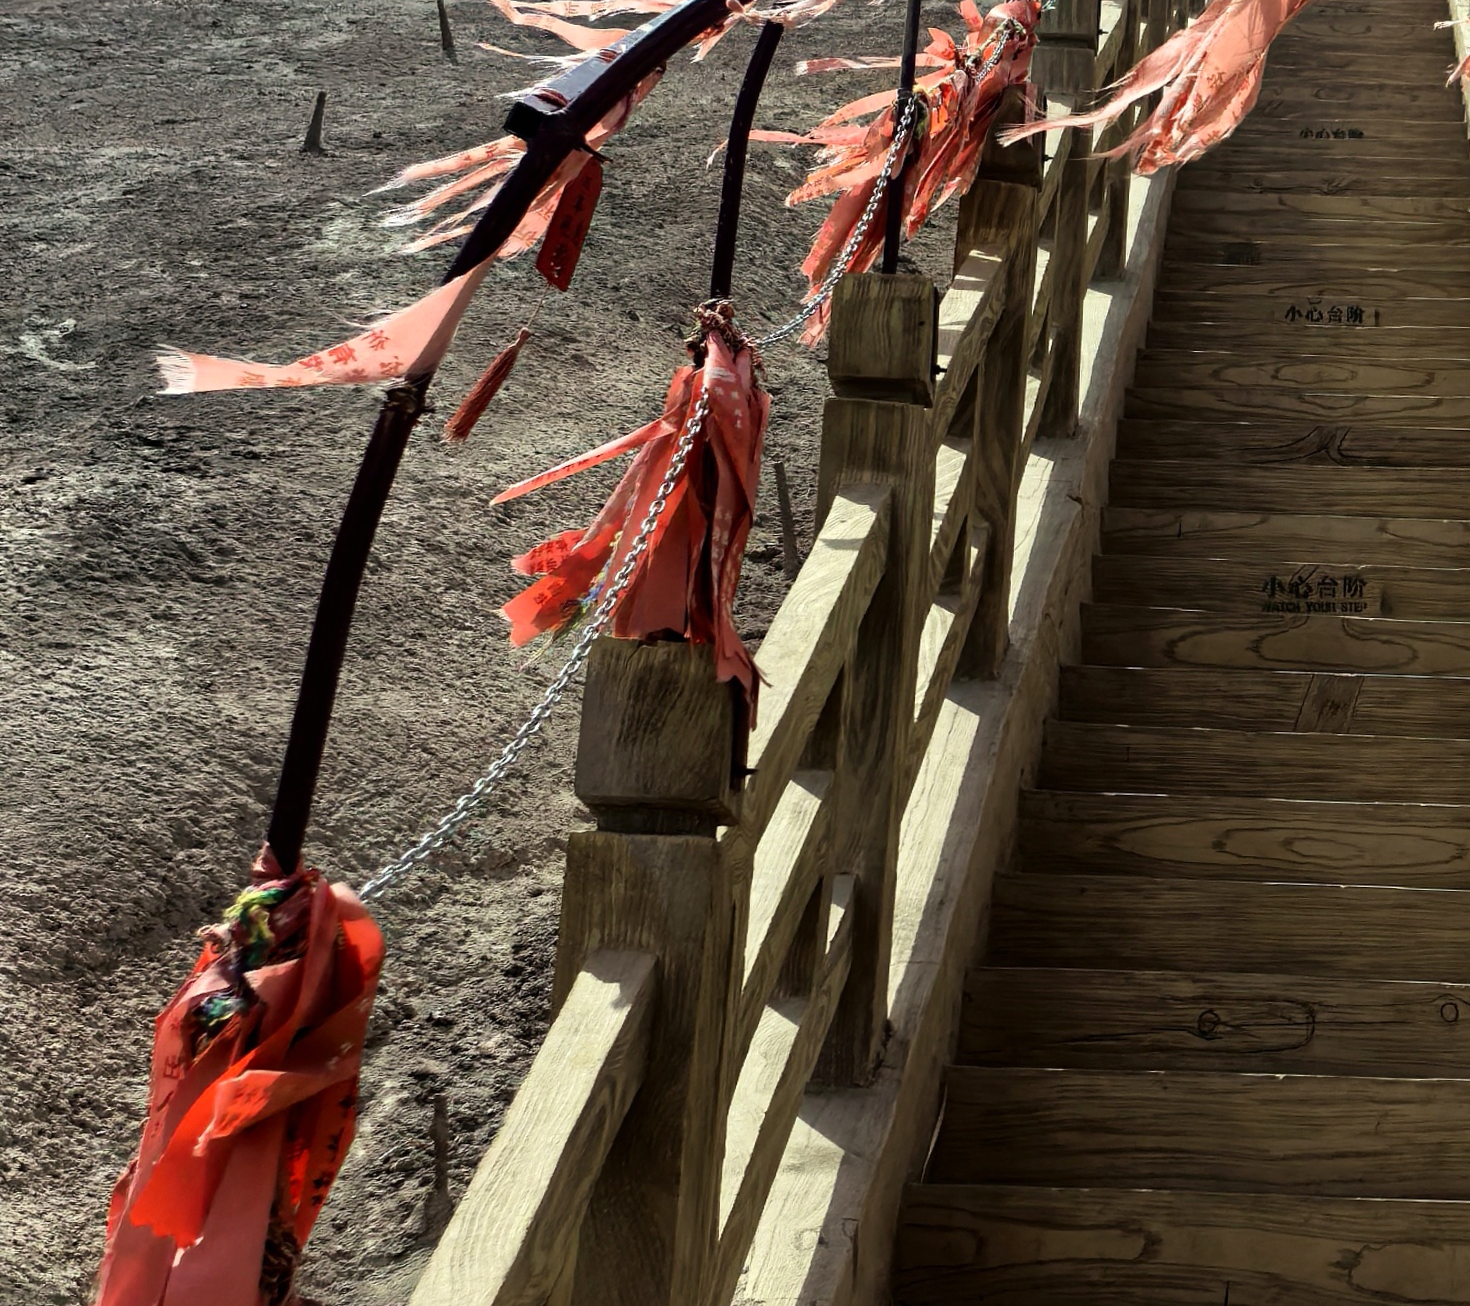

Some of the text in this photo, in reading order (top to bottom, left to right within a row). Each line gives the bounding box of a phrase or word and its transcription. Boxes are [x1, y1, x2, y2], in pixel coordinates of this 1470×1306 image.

[1284, 305, 1366, 324] 小心台阶
[1262, 575, 1368, 599] 小心台阶
